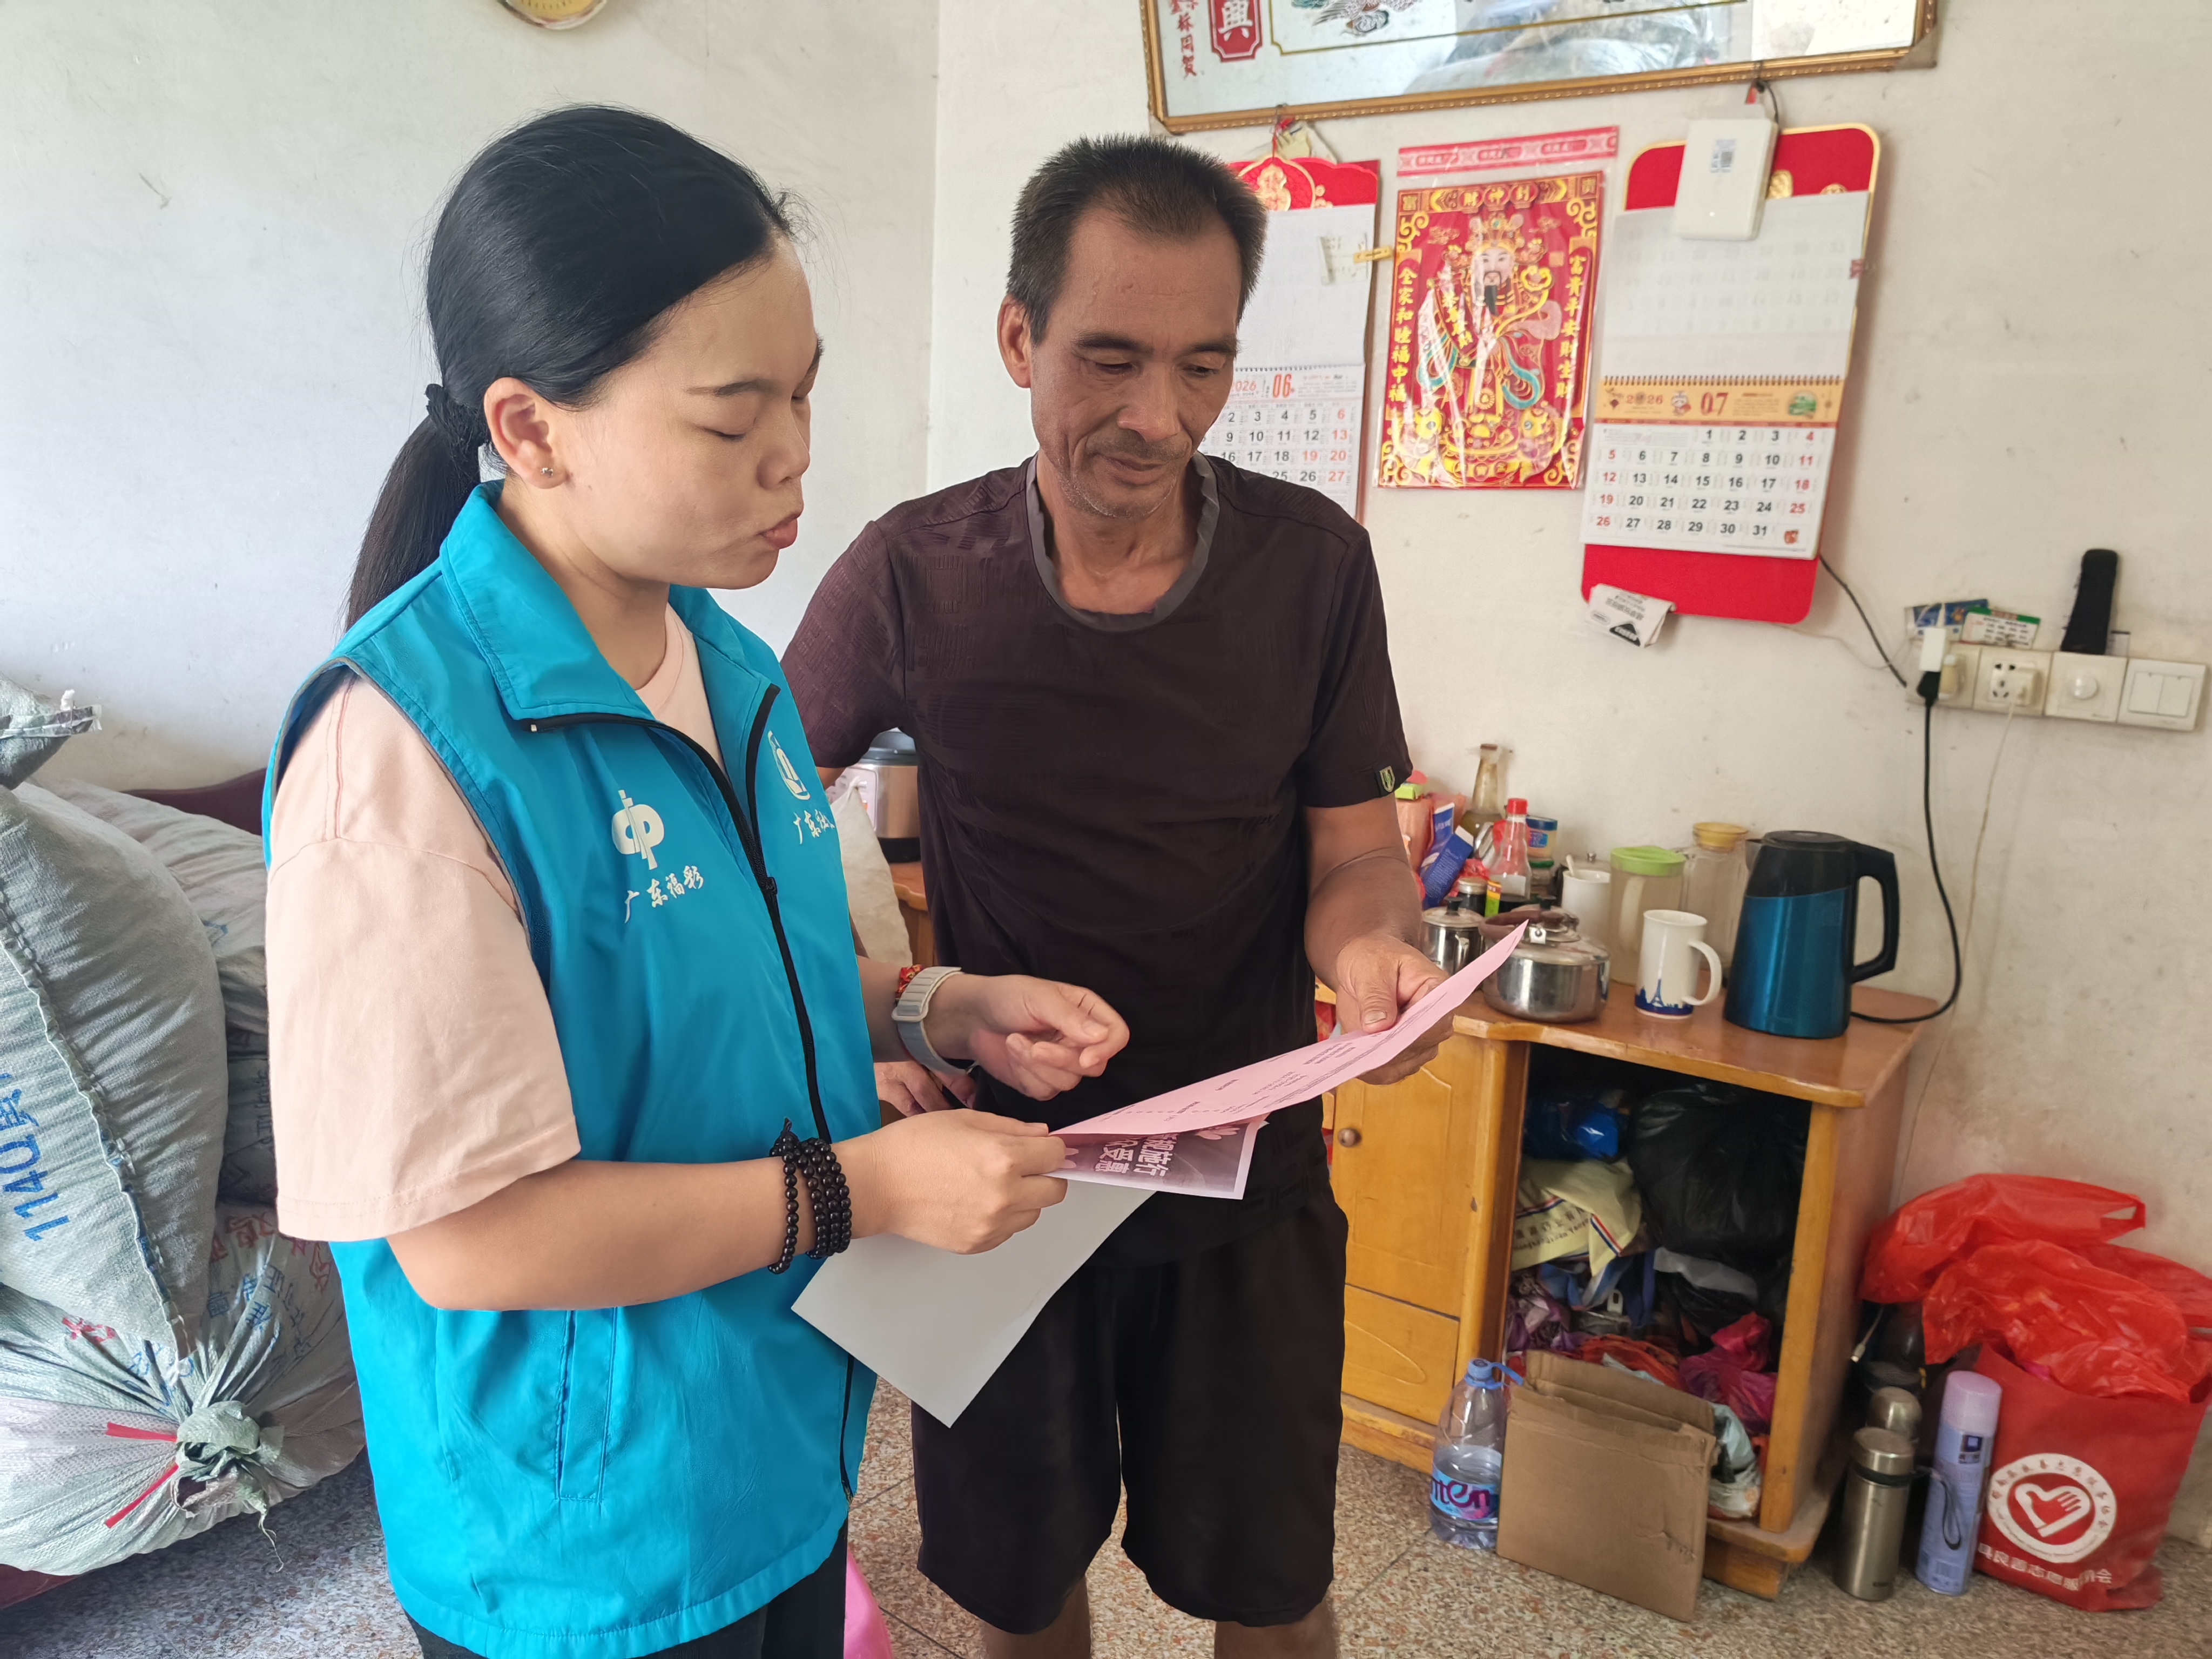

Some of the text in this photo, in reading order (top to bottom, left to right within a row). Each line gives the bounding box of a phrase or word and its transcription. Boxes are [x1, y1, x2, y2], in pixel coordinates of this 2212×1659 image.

[1389, 267, 1418, 402] 全家和睦福中福
[1231, 380, 1257, 392] 026
[1272, 374, 1292, 398] 06
[1701, 392, 1729, 417] 07
[1228, 408, 1346, 423] 2 3 4 5 6
[1226, 429, 1348, 442] 9 10 11 12 13
[1705, 430, 1815, 442] 1 2 3 4
[1222, 450, 1347, 462] 16 17 18 19 20
[1608, 449, 1813, 466] 5 6 7 8 9 10 11
[1272, 470, 1345, 482] 25 26 27
[1603, 471, 1810, 490] 12 13 14 15 16 17 18
[1600, 494, 1806, 514] 19 20 21 22 23 24 25
[1596, 516, 1768, 537] 26 27 28 29 30 31
[624, 865, 704, 924] 广东福彩
